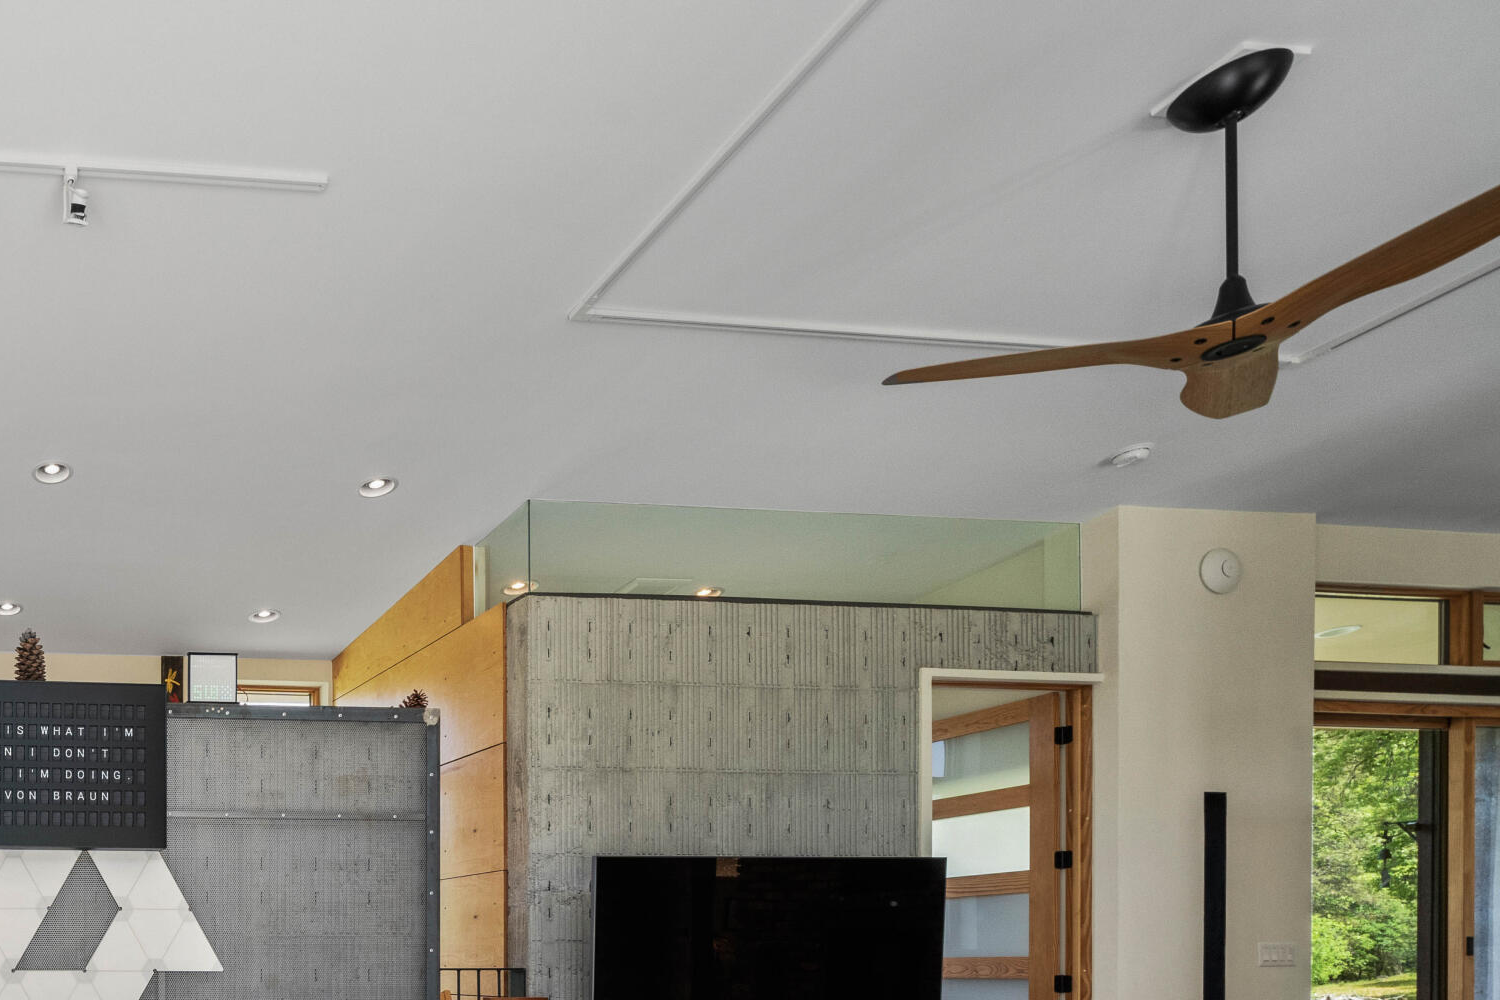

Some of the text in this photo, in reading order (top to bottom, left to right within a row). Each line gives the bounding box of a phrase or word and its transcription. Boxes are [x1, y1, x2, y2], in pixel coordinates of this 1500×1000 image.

[5, 725, 24, 735] IS
[40, 725, 85, 736] WHAT
[102, 727, 134, 737] I'M
[53, 748, 109, 758] DON'T
[17, 768, 49, 779] I'M
[65, 769, 132, 781] DOING.
[4, 790, 37, 800] VON
[53, 791, 109, 801] BRAUN
